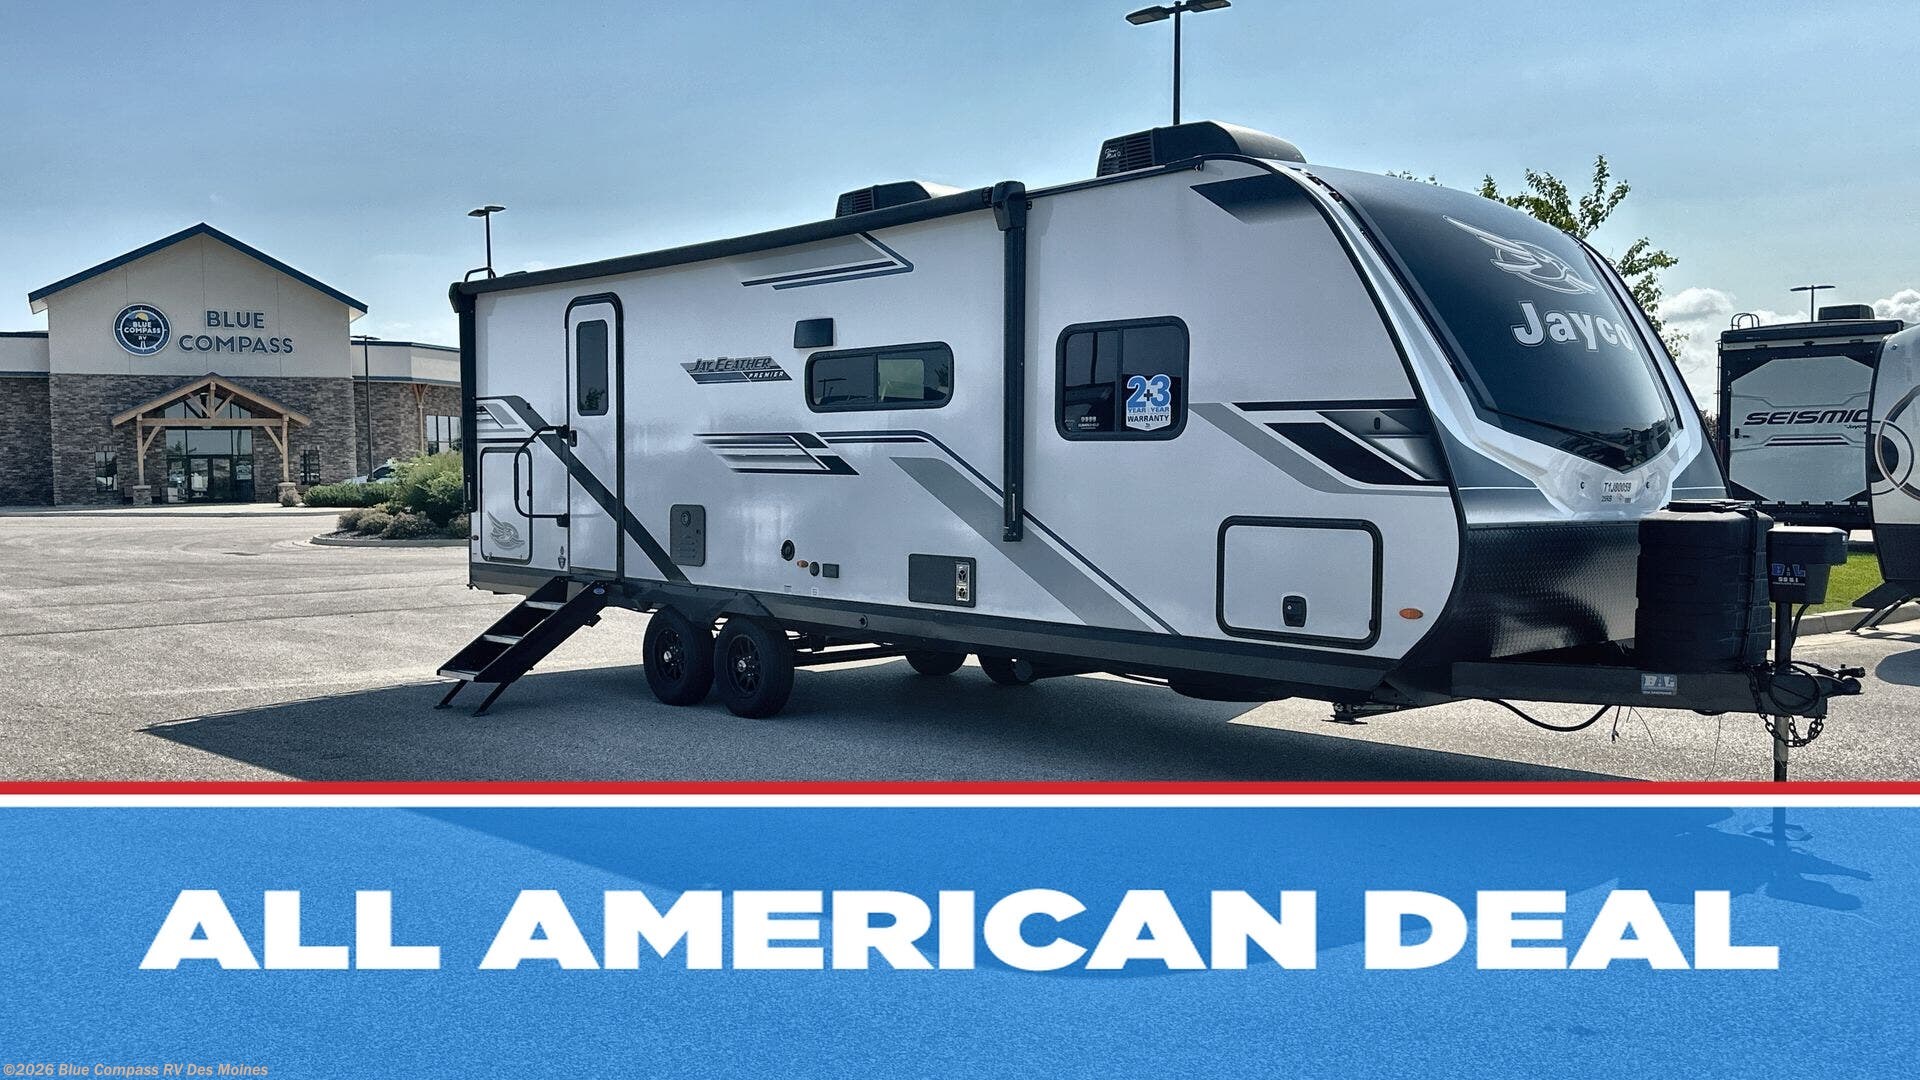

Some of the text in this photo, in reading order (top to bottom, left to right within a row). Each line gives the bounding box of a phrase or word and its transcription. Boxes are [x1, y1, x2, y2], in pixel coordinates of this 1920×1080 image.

[206, 310, 265, 329] BLUE
[1512, 301, 1634, 351] Jayco
[178, 335, 293, 354] COMPASS
[748, 371, 784, 379] PREMIER
[1127, 414, 1170, 423] WARRANTY
[1743, 409, 1868, 425] SEISMIC
